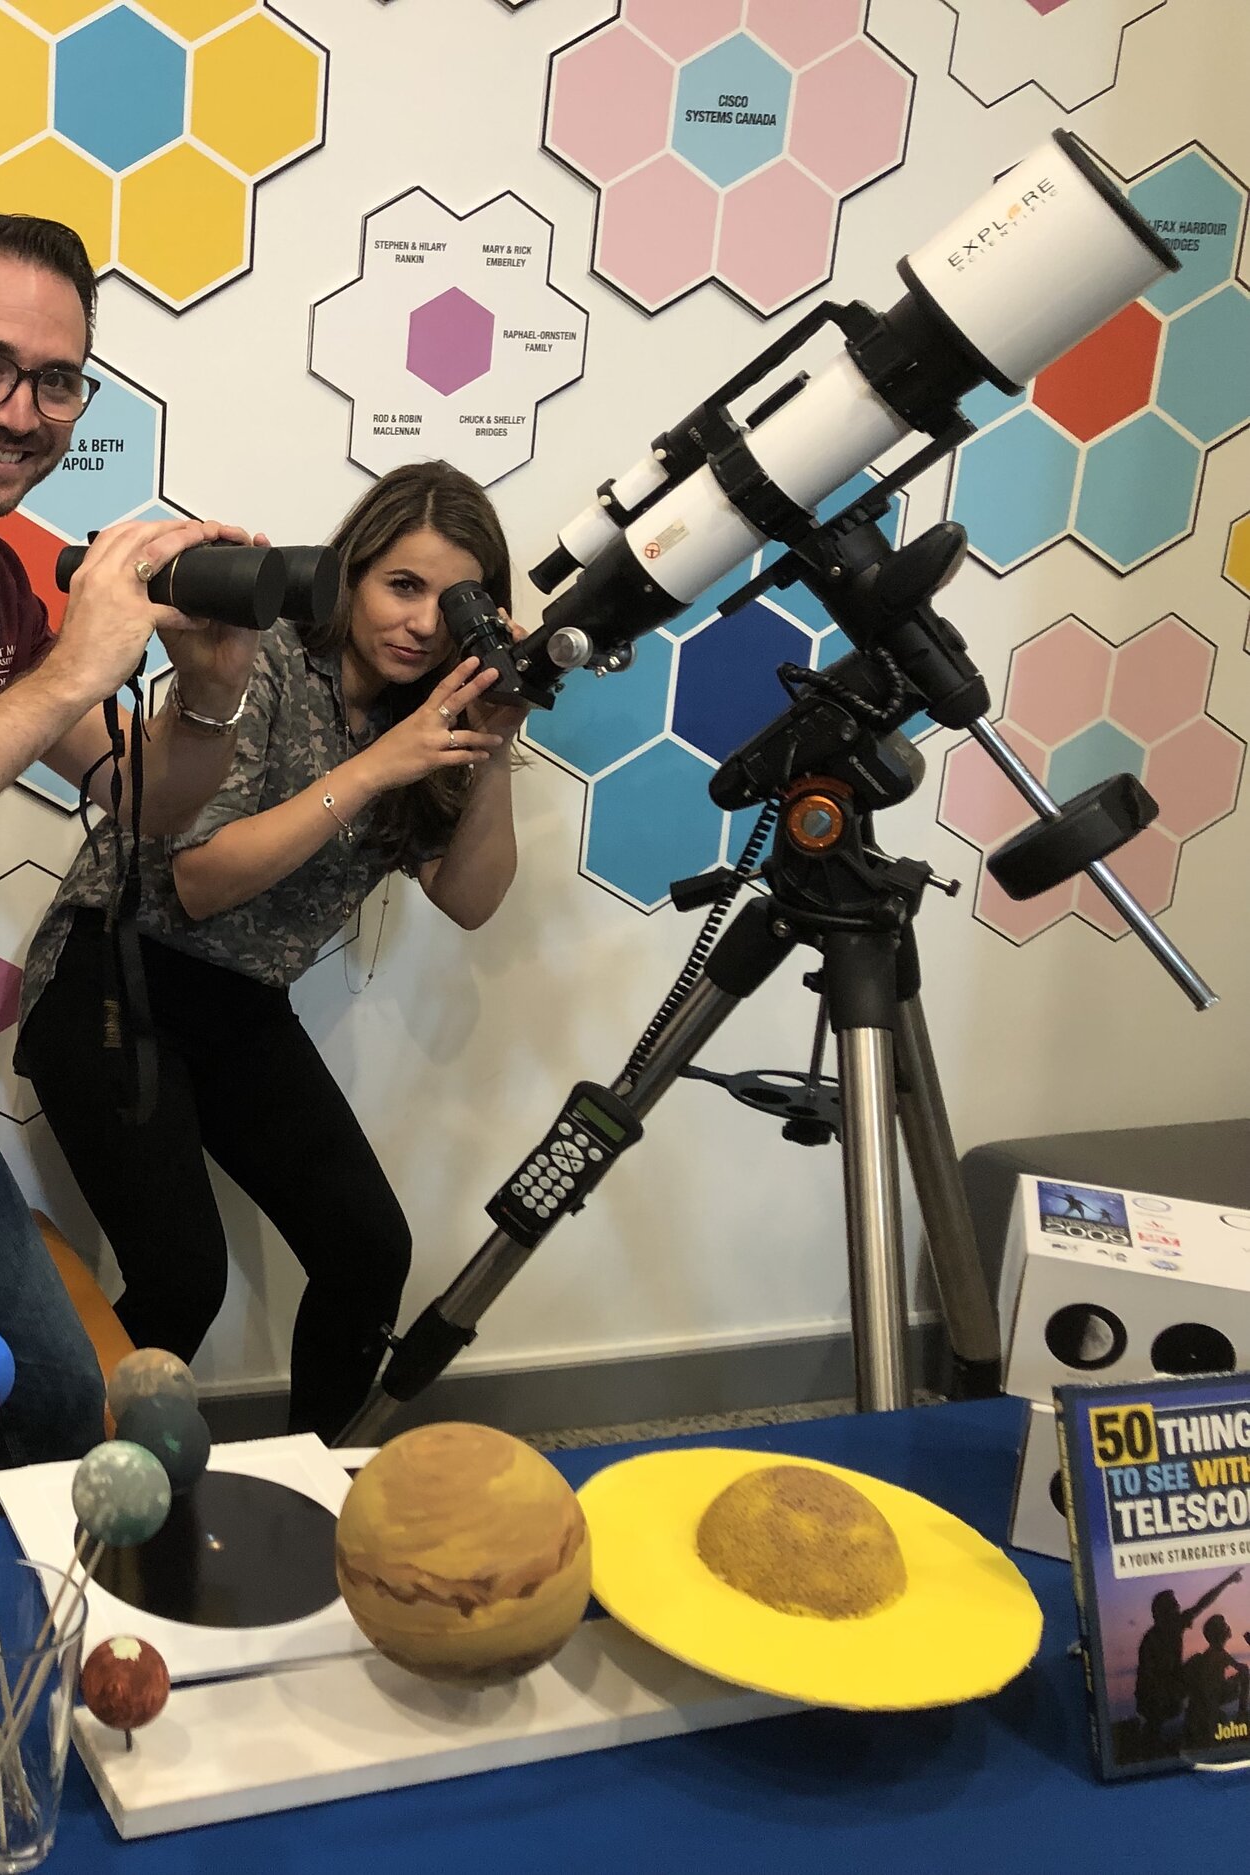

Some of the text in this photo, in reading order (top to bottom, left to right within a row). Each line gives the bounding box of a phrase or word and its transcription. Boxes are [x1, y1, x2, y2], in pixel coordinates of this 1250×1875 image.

[718, 94, 749, 108] CISCO
[685, 109, 777, 126] SYSTEMS CANADA
[1179, 221, 1227, 236] HARBOUR
[374, 240, 447, 252] STEPHEN & HILARY
[482, 244, 532, 255] MARY & RICK
[395, 254, 424, 264] RANKIN
[486, 257, 526, 267] EMBERLEY
[503, 330, 577, 340] RAPHAEL-ORNSTEIN
[525, 343, 553, 353] FAMILY
[373, 414, 422, 424] ROD & ROBIN
[459, 415, 526, 425] CHUCK & SHELLEY
[373, 426, 421, 436] MACLENNAN
[475, 427, 508, 437] BRIDGES
[78, 438, 88, 453] &
[91, 438, 124, 453] BETH
[62, 457, 104, 471] APOLD
[1094, 1410, 1153, 1463] 50
[1108, 1467, 1142, 1497] TO
[1146, 1461, 1190, 1493] SEE
[1114, 1488, 1250, 1538] TELESCO
[1119, 1556, 1126, 1569] A
[1129, 1551, 1164, 1567] YOUNG
[1167, 1540, 1236, 1563] STARGAZER'S
[1214, 1721, 1247, 1740] John
